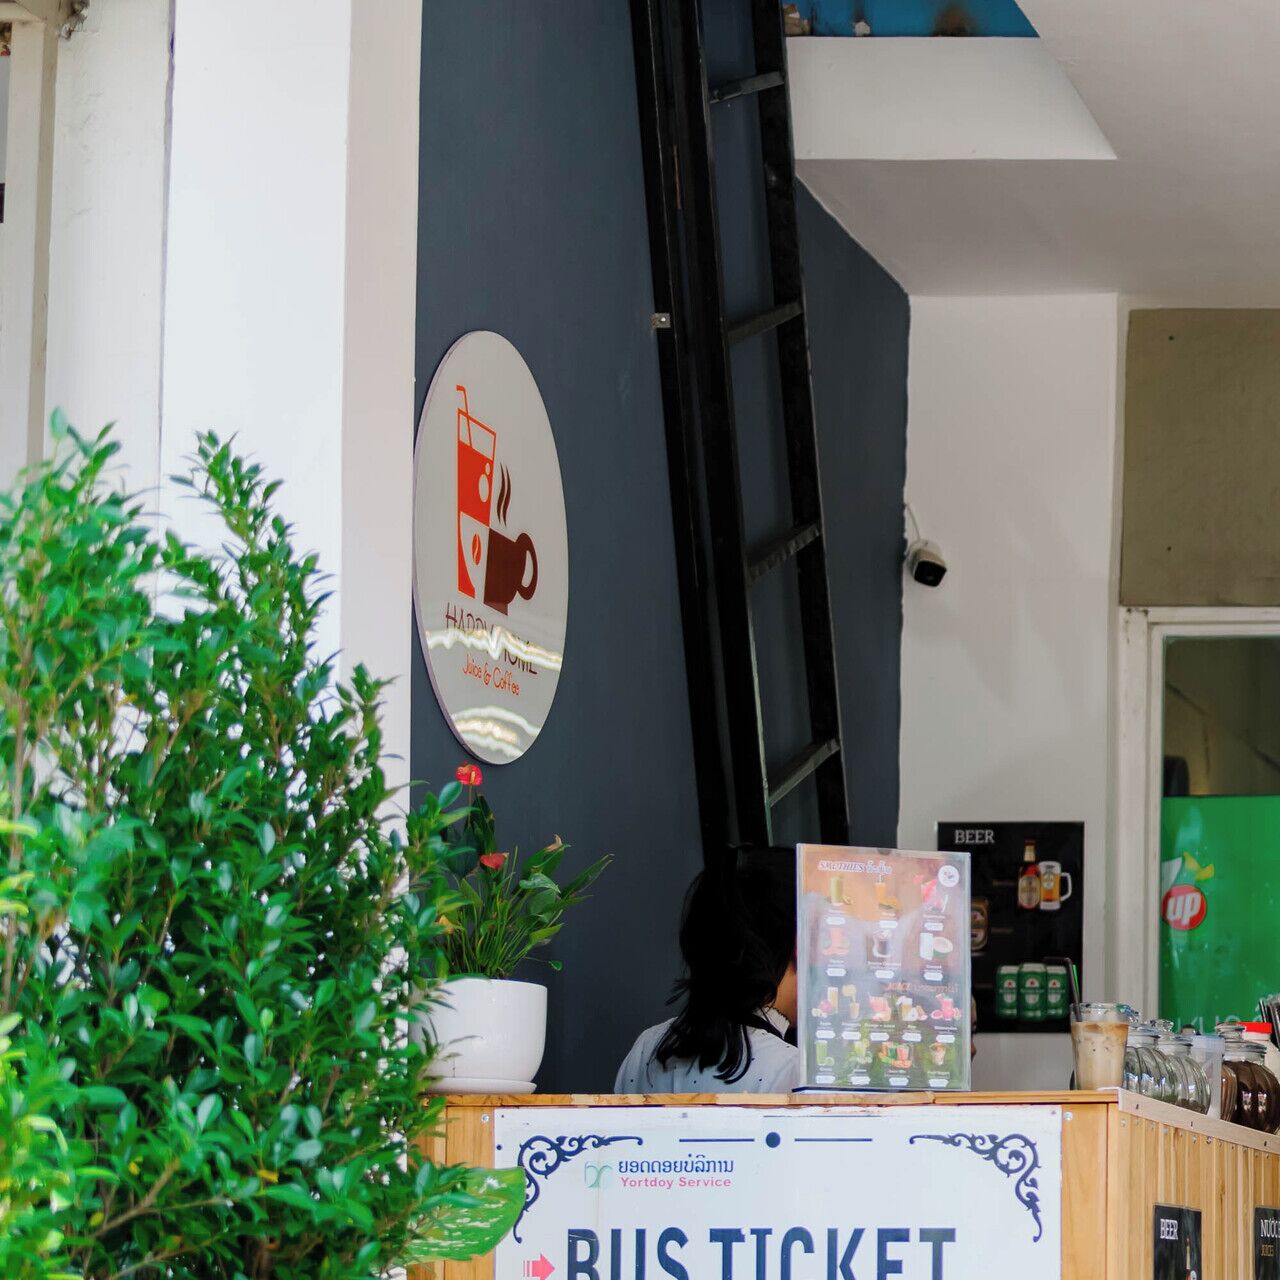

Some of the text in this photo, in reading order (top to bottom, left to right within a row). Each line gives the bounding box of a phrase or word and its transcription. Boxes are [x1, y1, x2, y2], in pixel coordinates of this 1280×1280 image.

[463, 653, 482, 679] Juice
[494, 666, 521, 696] Coffee
[955, 829, 995, 844] BEER
[620, 1176, 732, 1189] Yortdoy Service
[1160, 1219, 1178, 1239] BEER
